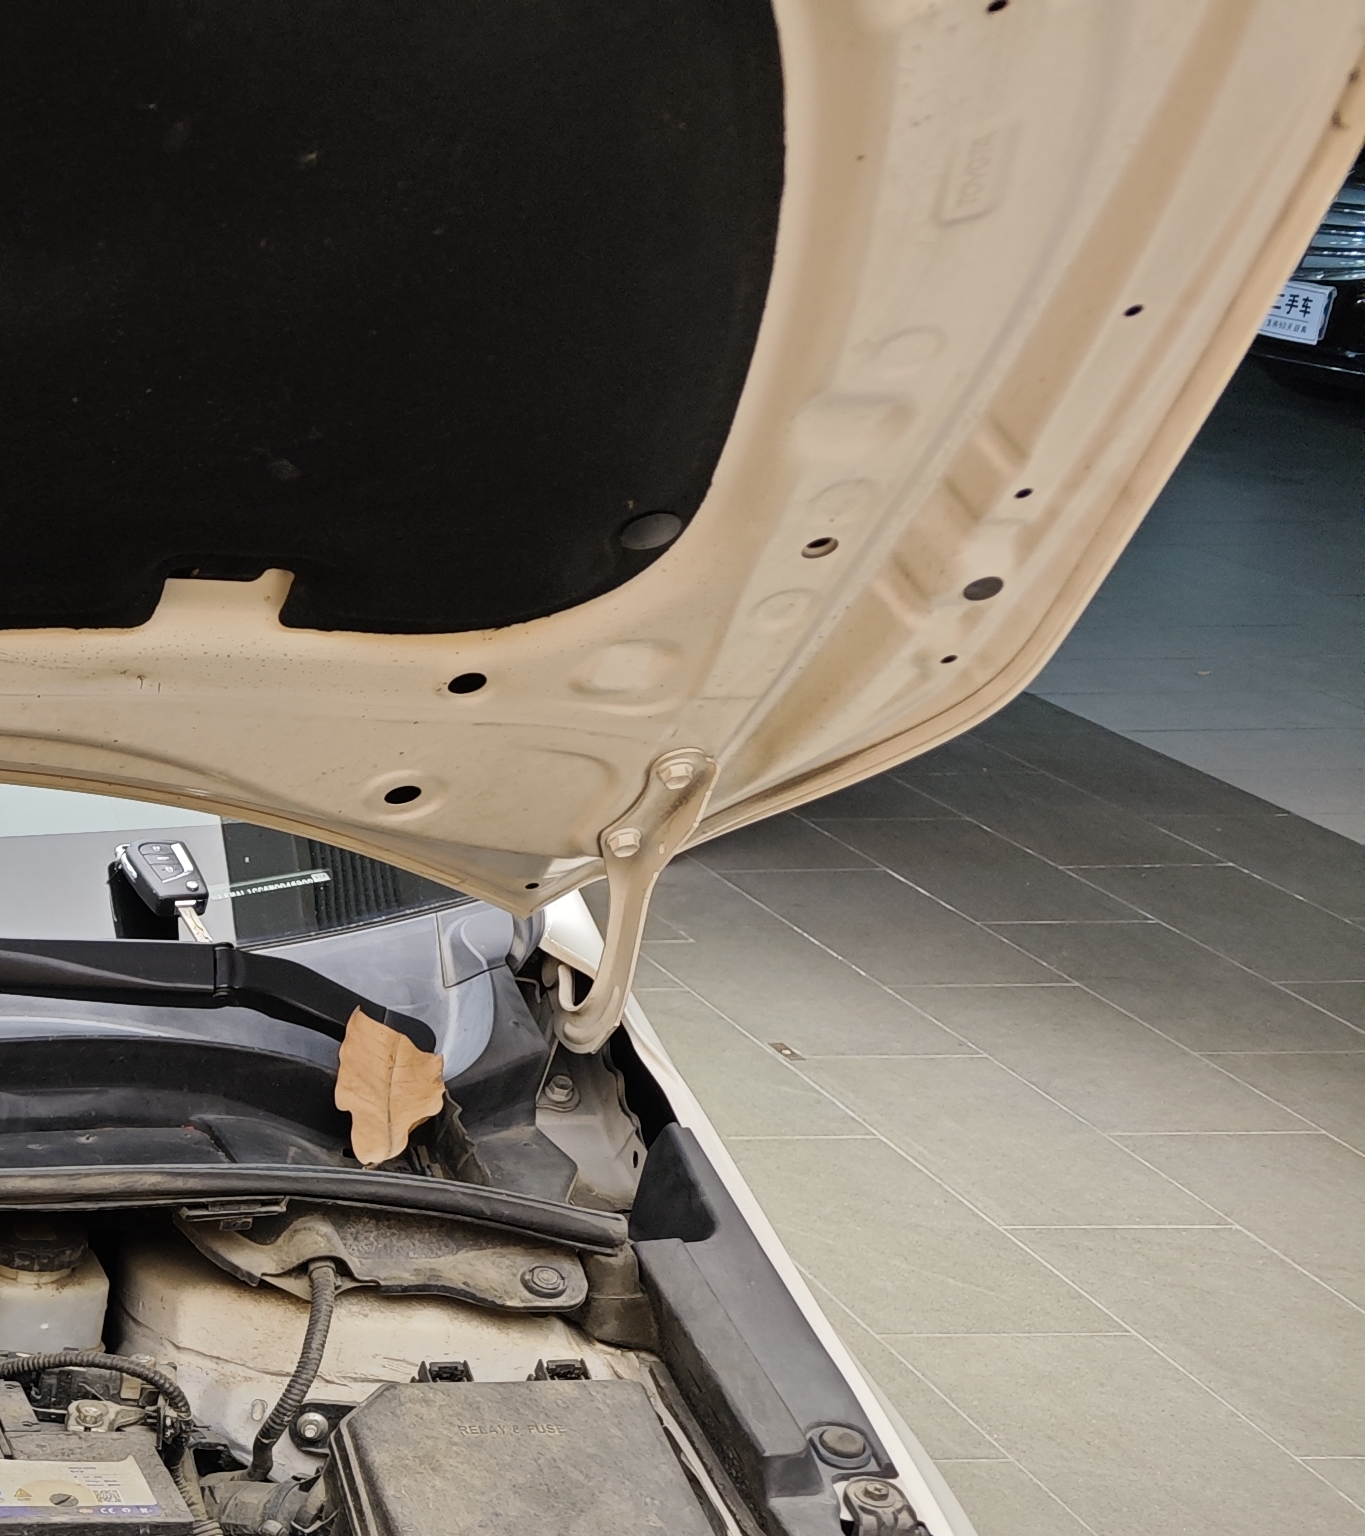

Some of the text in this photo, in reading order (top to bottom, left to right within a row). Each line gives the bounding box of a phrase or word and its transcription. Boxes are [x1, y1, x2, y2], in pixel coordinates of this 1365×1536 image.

[956, 131, 998, 208] TOYOTA
[457, 1424, 506, 1436] RELAY
[527, 1424, 567, 1434] FUSE
